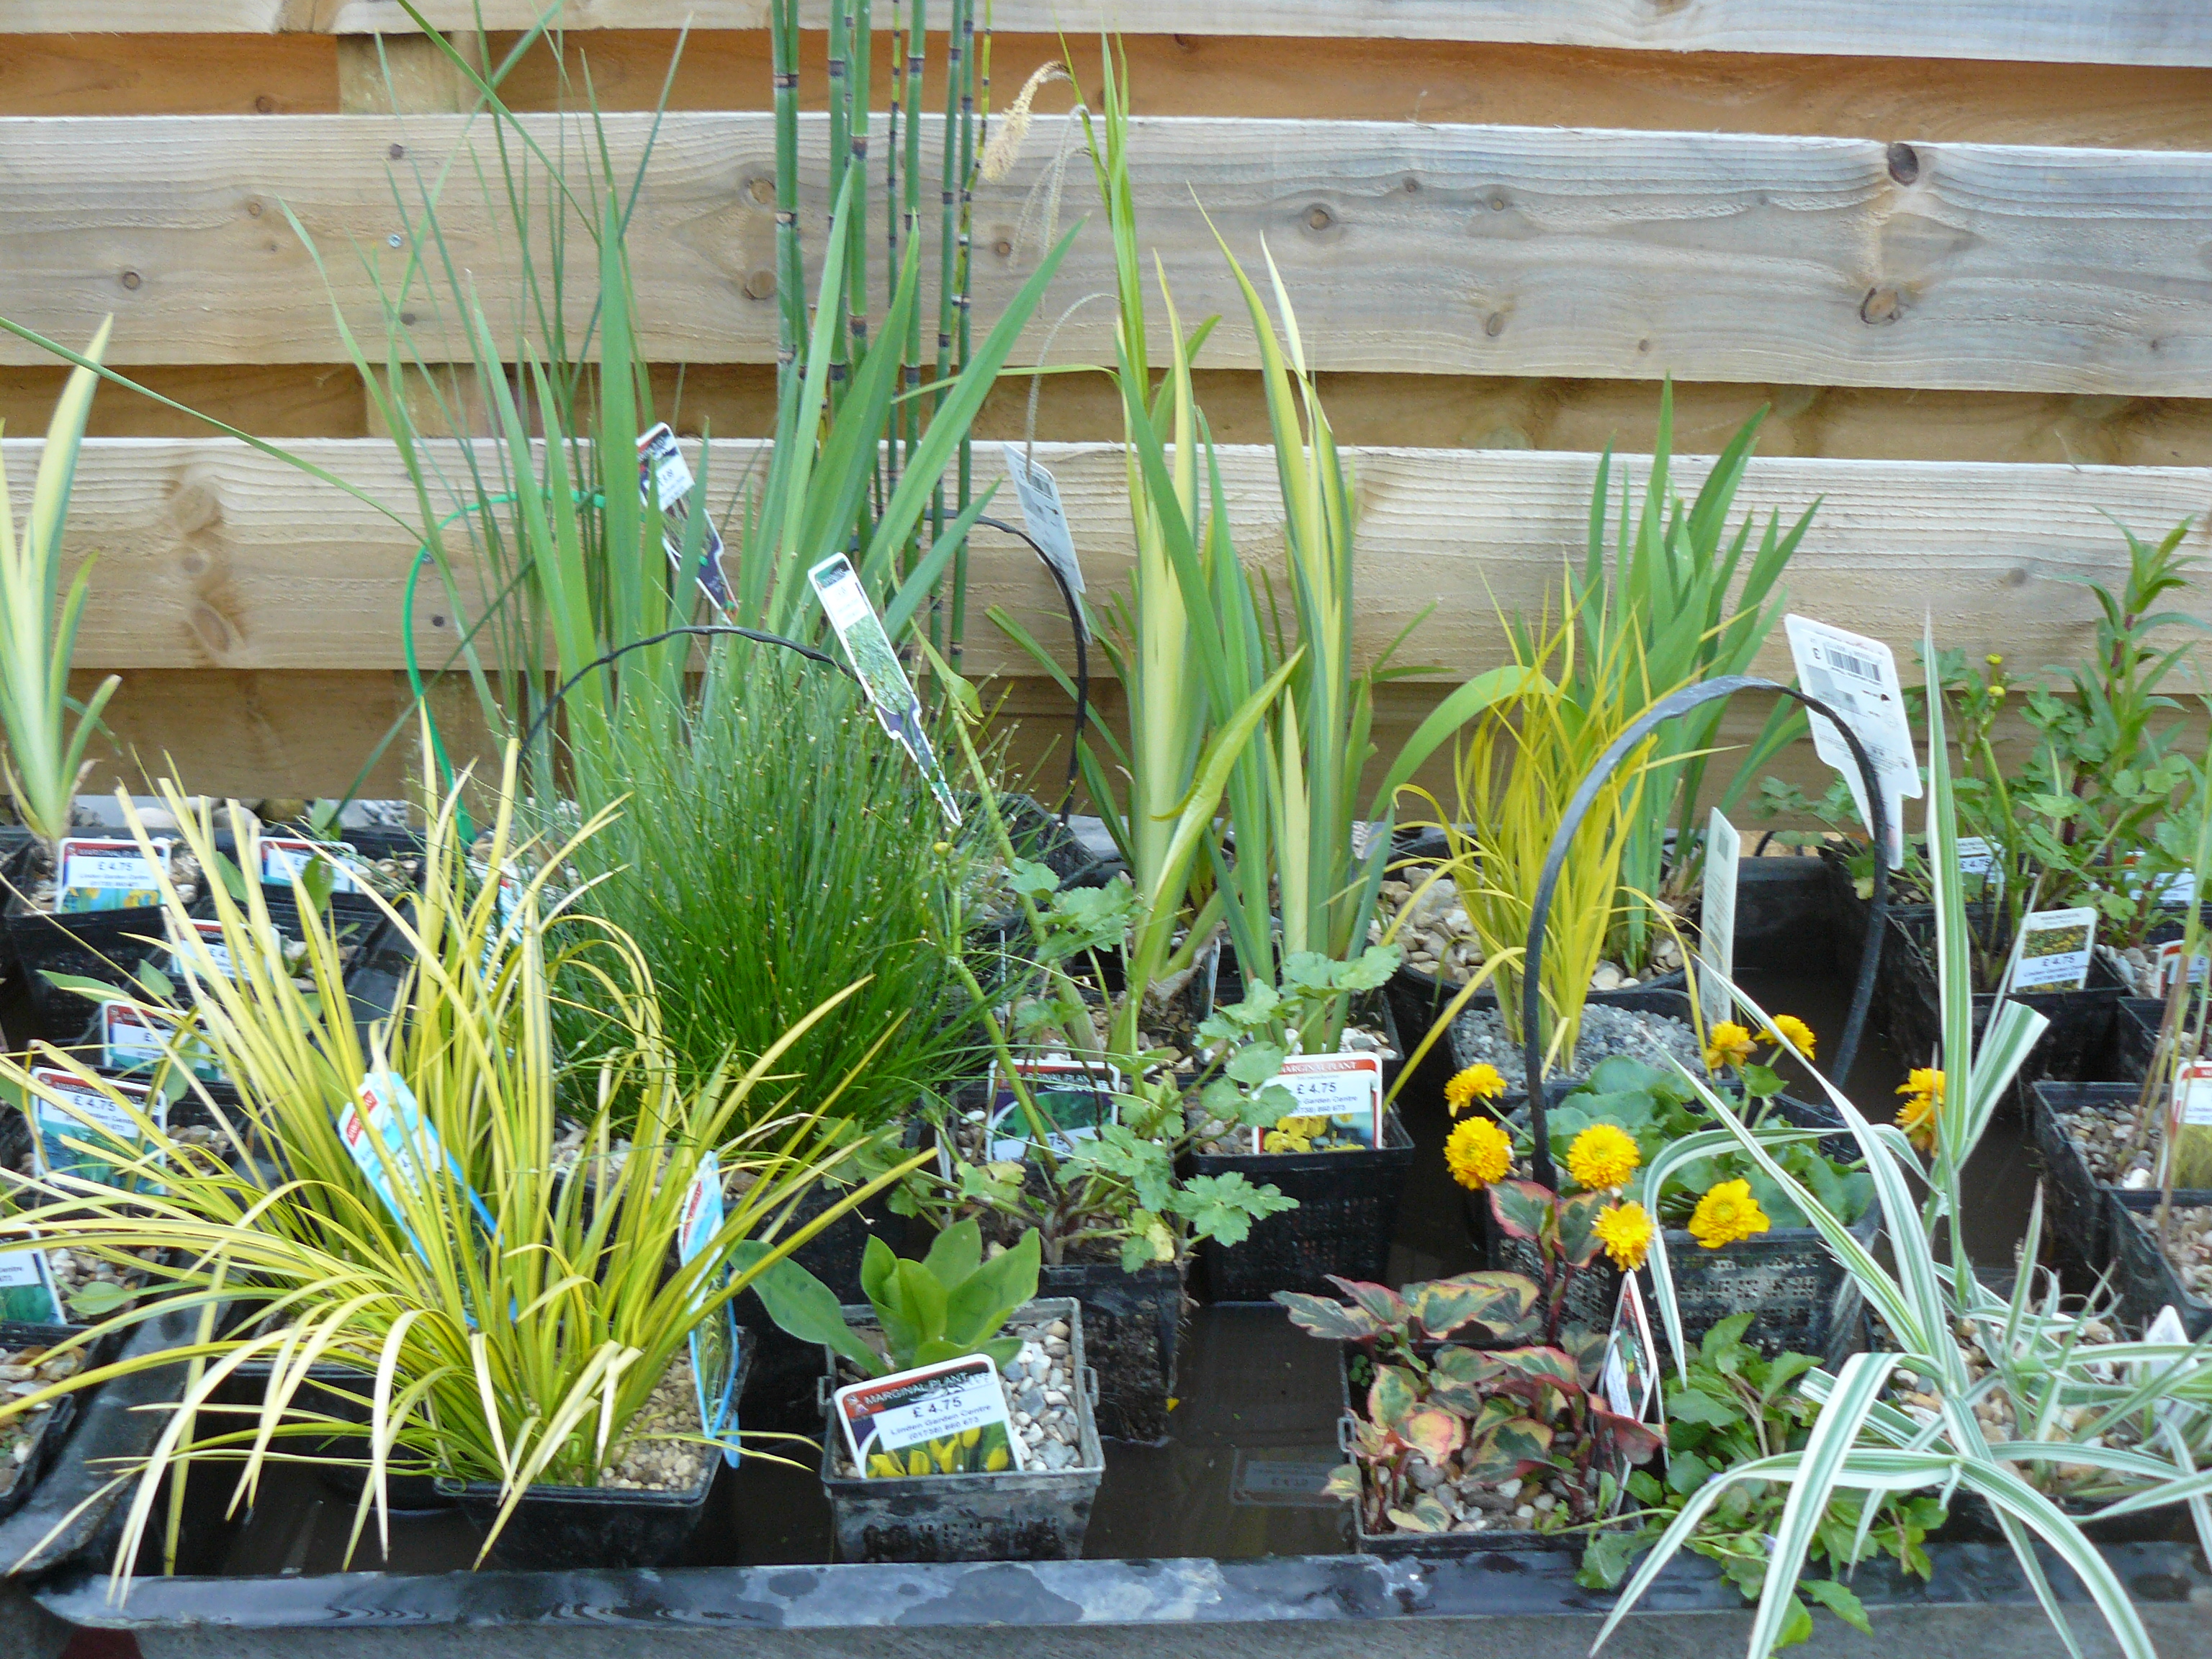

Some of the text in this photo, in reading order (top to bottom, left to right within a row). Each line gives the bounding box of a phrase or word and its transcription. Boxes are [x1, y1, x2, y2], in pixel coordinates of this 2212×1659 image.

[109, 861, 133, 871] 4.75
[1297, 1082, 1337, 1094] £ 4.75
[73, 1095, 83, 1106] £
[86, 1098, 116, 1112] 4.75
[864, 1383, 929, 1405] MARGINAL
[929, 1372, 968, 1393] PLANT
[912, 1395, 963, 1419] £ 4.75
[890, 1404, 992, 1436] Linden Garden Centre
